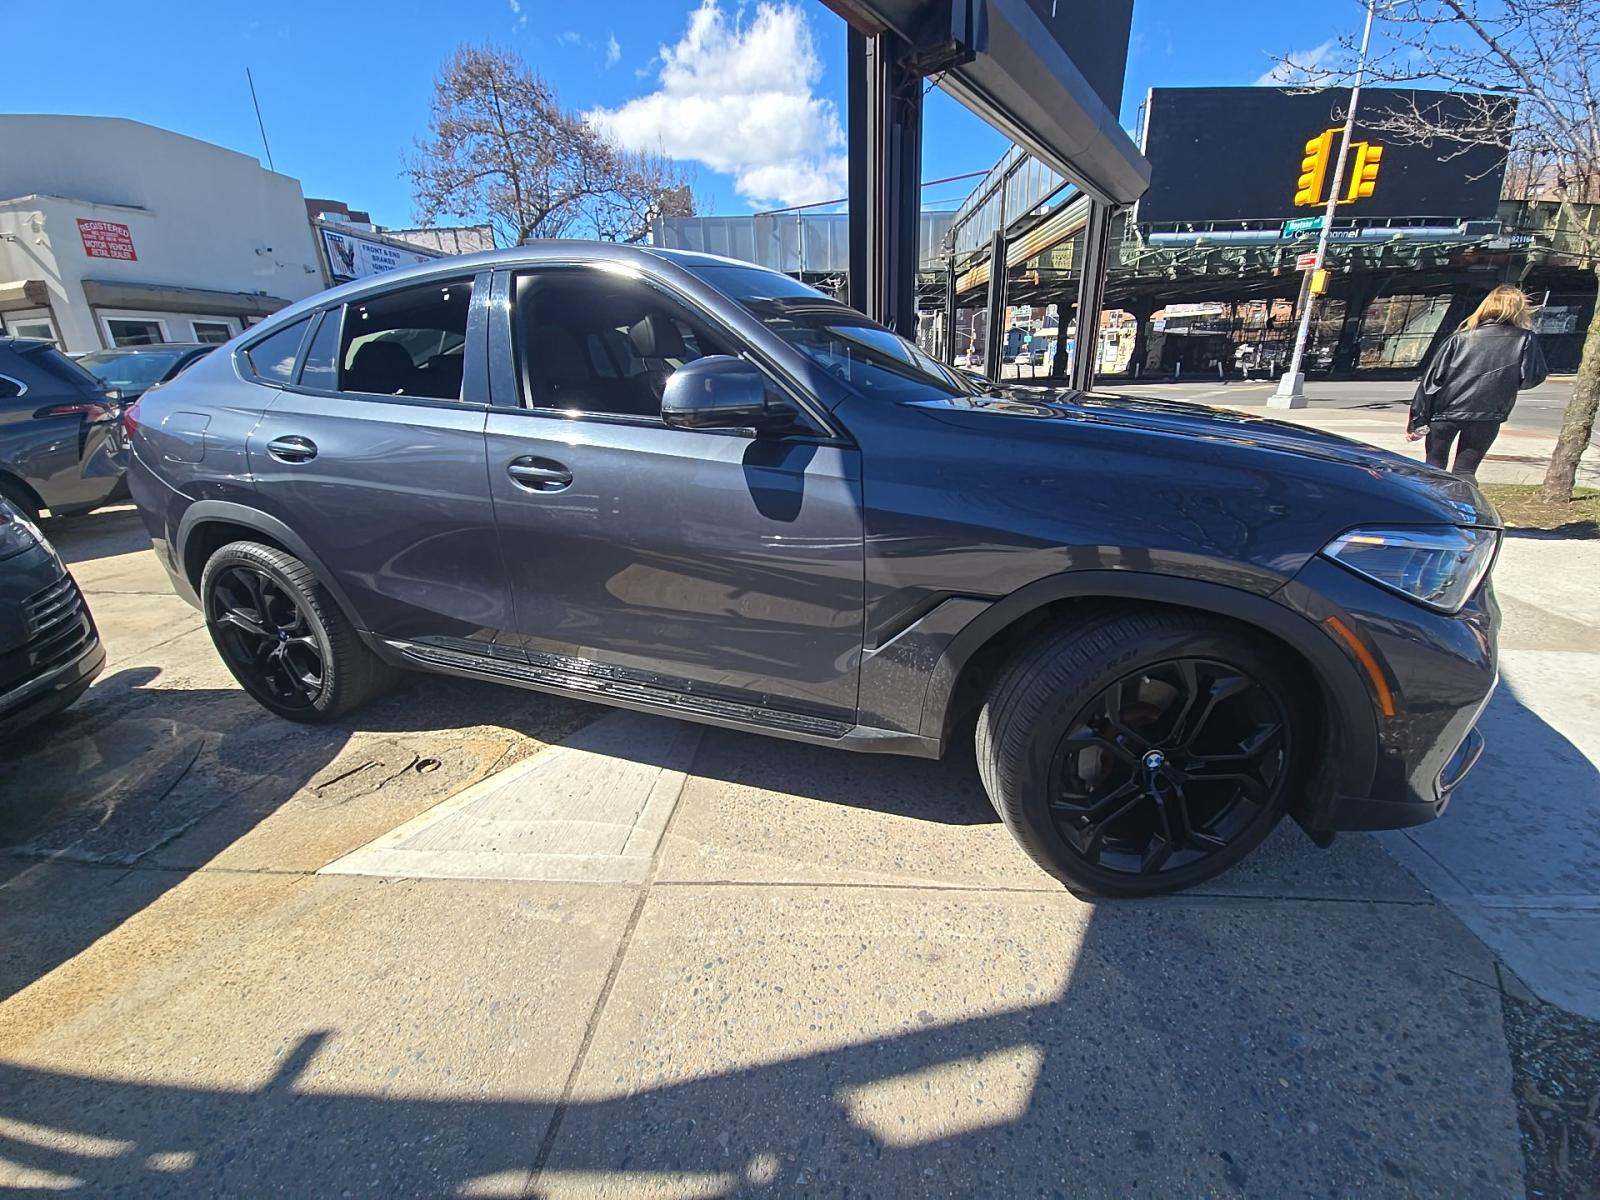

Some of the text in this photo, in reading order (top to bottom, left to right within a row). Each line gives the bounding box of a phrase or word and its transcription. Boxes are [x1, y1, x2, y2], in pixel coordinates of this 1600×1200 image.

[80, 222, 129, 237] REGISTERED
[84, 239, 133, 252] MOTOR VEHICLE
[362, 244, 382, 254] FRONT
[371, 254, 396, 266] BRAKES
